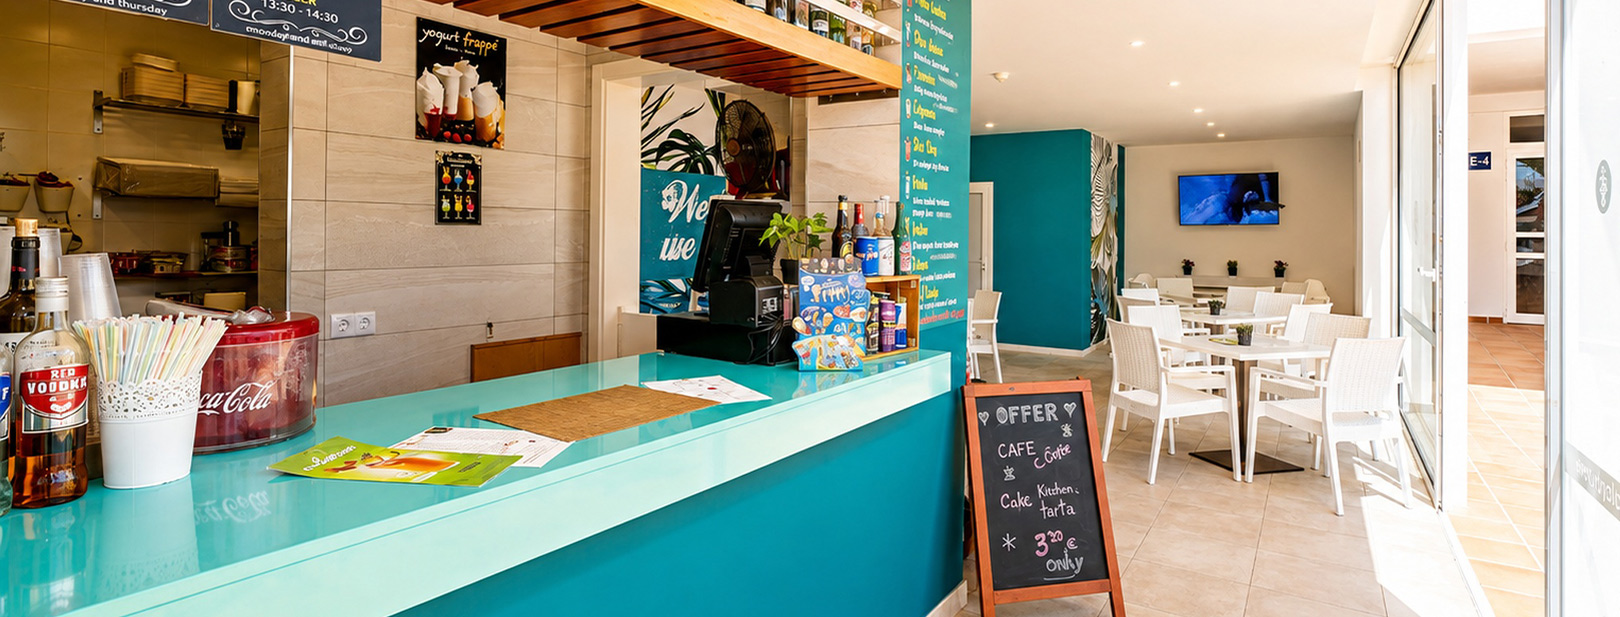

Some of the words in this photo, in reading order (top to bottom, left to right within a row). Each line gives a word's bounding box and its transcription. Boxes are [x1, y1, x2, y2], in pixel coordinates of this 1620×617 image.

[118, 0, 168, 16] thursday
[263, 0, 296, 14] 13:30
[306, 8, 339, 24] 14:30
[418, 28, 460, 47] yogurt
[1470, 156, 1489, 165] E-4
[198, 379, 276, 415] ca-Cola
[995, 402, 1059, 425] OFFER
[997, 440, 1037, 459] CAFE
[1000, 491, 1033, 511] Cake
[1040, 499, 1076, 519] tarta
